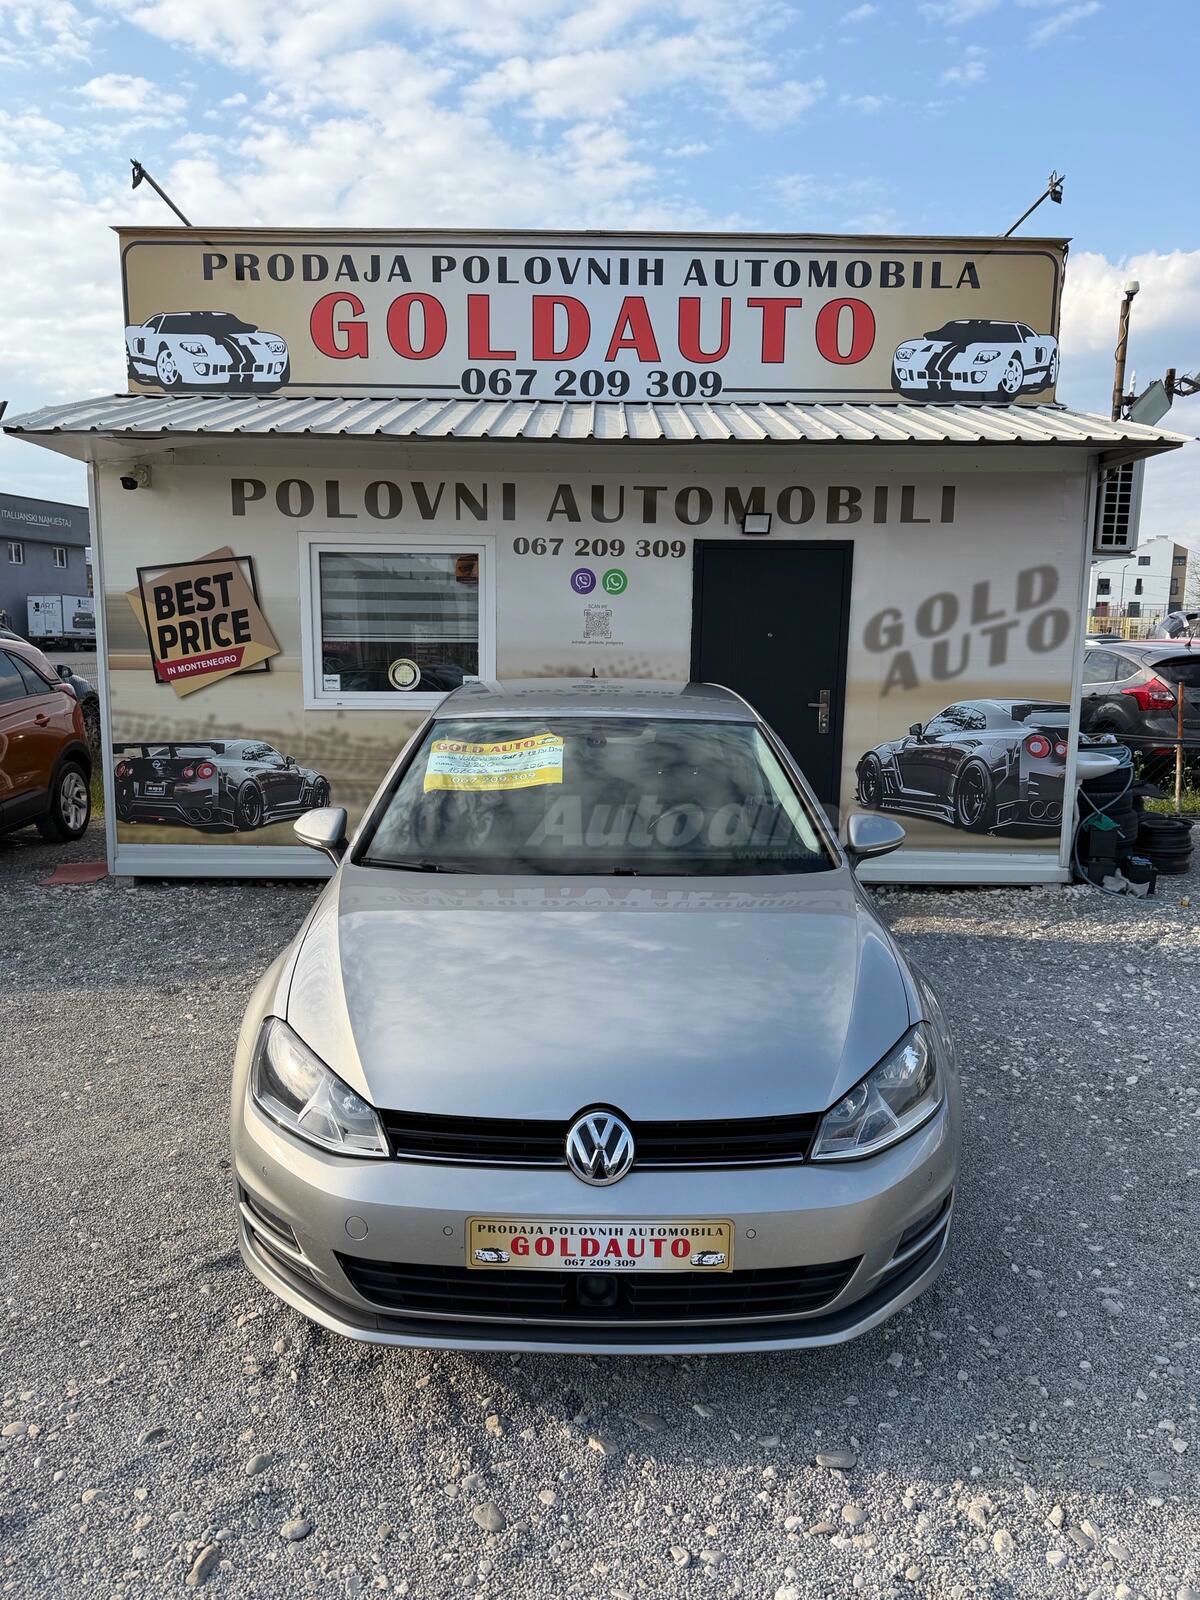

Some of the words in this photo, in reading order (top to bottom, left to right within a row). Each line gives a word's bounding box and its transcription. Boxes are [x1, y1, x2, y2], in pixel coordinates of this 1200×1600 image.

[202, 252, 413, 284] PRODAJA
[431, 255, 665, 287] POLOVNIH
[683, 258, 982, 290] AUTOMOBILA
[309, 290, 877, 365] GOLDAUTO
[460, 368, 538, 397] 067
[554, 369, 631, 398] 209
[646, 370, 723, 399] 309
[230, 477, 517, 521] POLOVNI
[546, 483, 957, 526] AUTOMOBILI
[512, 536, 565, 556] 067
[574, 538, 626, 557] 209
[635, 539, 687, 558] 309
[152, 571, 234, 621] BEST
[862, 563, 1061, 654] GOLD
[157, 608, 252, 660] PRICE
[166, 667, 177, 676] IN
[177, 654, 238, 674] MONTENEGRO
[880, 607, 1072, 698] AUTO
[436, 743, 485, 753] GOLD
[489, 740, 537, 753] AUTO
[477, 1224, 544, 1235] PRODAJA
[549, 1226, 624, 1237] POLOVNIH
[629, 1227, 724, 1238] AUTOMOBILA
[510, 1236, 692, 1258] GOLDAUTO
[564, 1258, 585, 1267] 067
[589, 1259, 611, 1268] 209
[614, 1259, 637, 1268] 309
